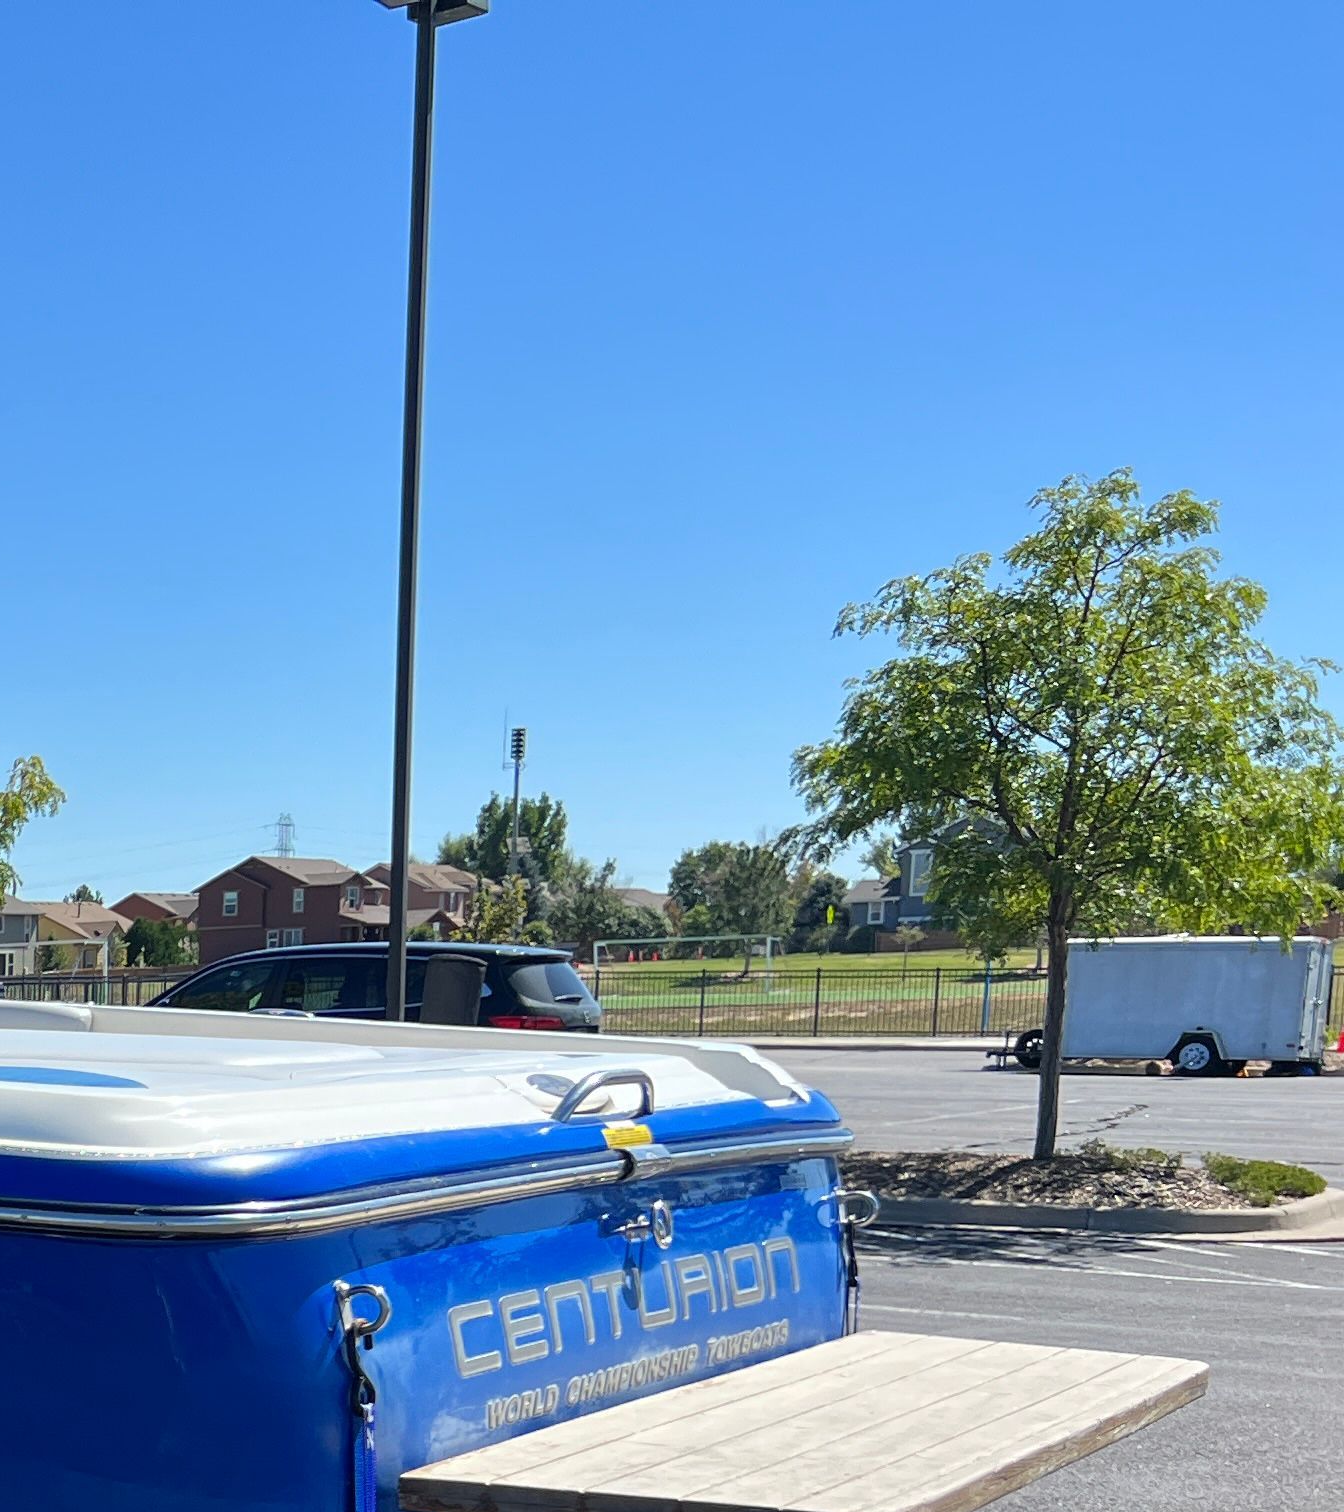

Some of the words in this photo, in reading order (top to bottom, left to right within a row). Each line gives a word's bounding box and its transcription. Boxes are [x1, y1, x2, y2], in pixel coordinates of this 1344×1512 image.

[447, 1236, 801, 1379] CENTURION
[486, 1383, 559, 1430] WORLD
[567, 1343, 699, 1406] CHAMPIONSHIP
[706, 1318, 789, 1368] TOWBOATS
